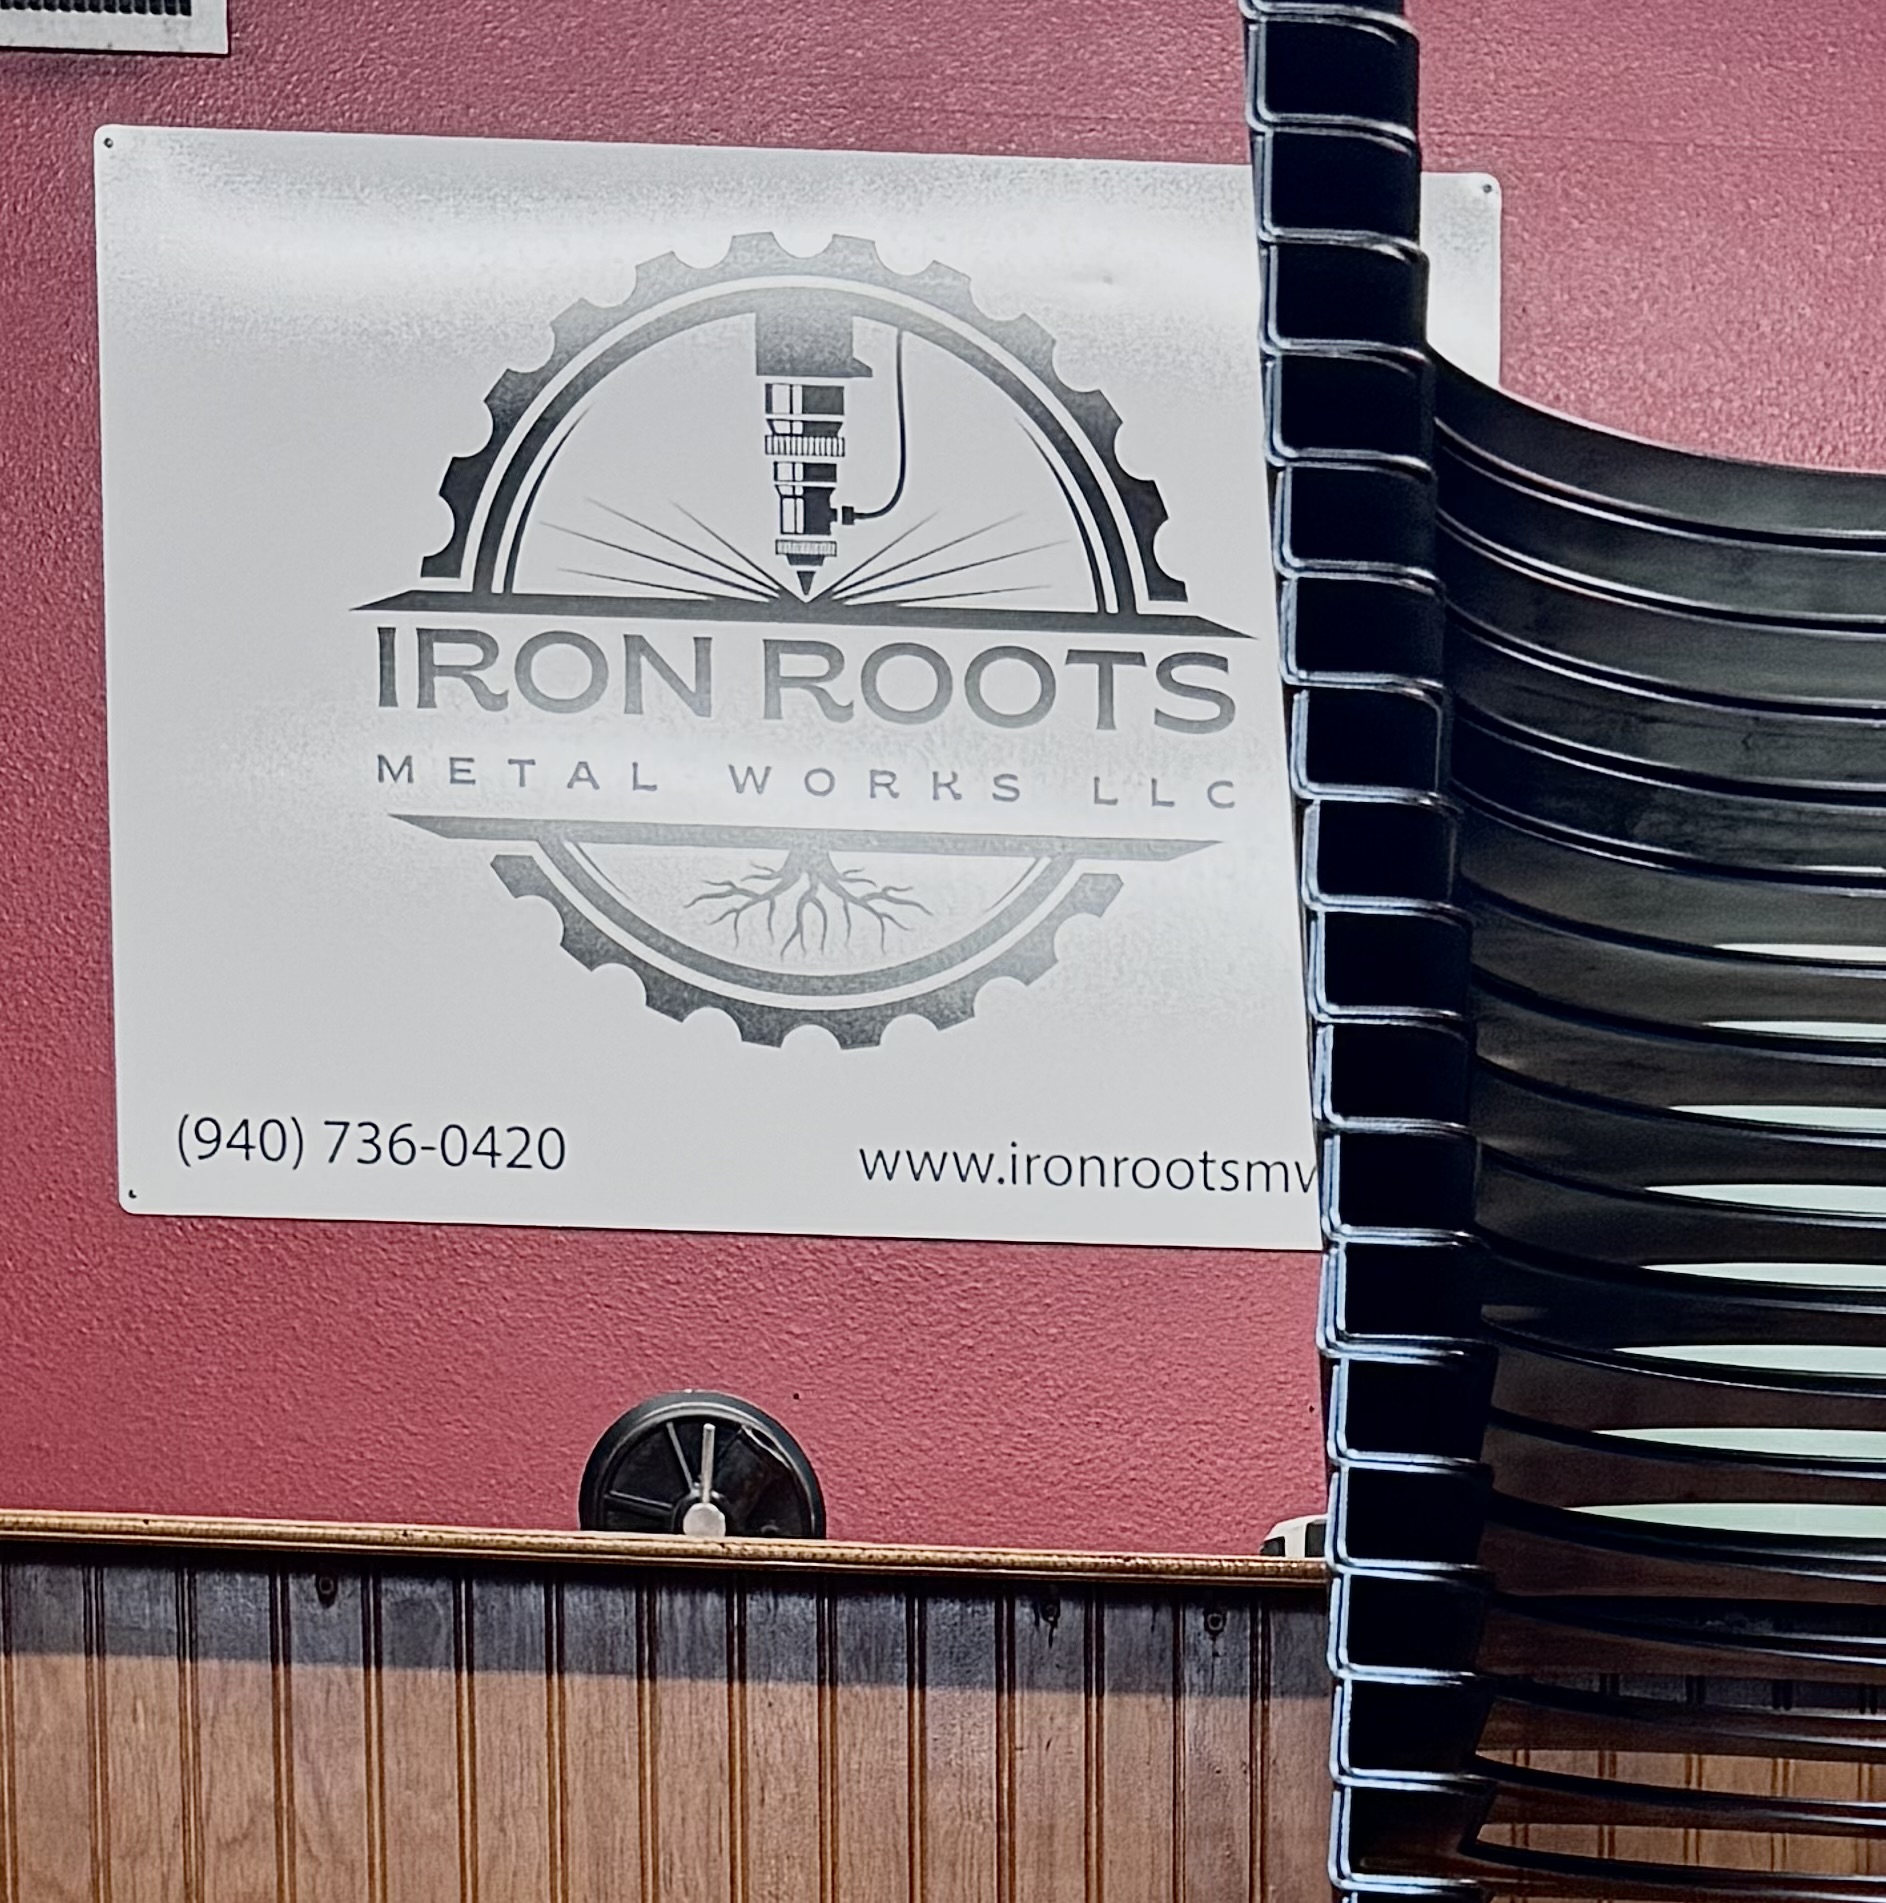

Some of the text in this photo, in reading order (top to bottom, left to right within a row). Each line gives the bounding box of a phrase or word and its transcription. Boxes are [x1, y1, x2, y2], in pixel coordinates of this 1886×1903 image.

[376, 626, 1236, 734] IRON ROOTS
[376, 753, 1237, 811] METAL WORKS LLC
[178, 1113, 566, 1171] (940) 736-0420
